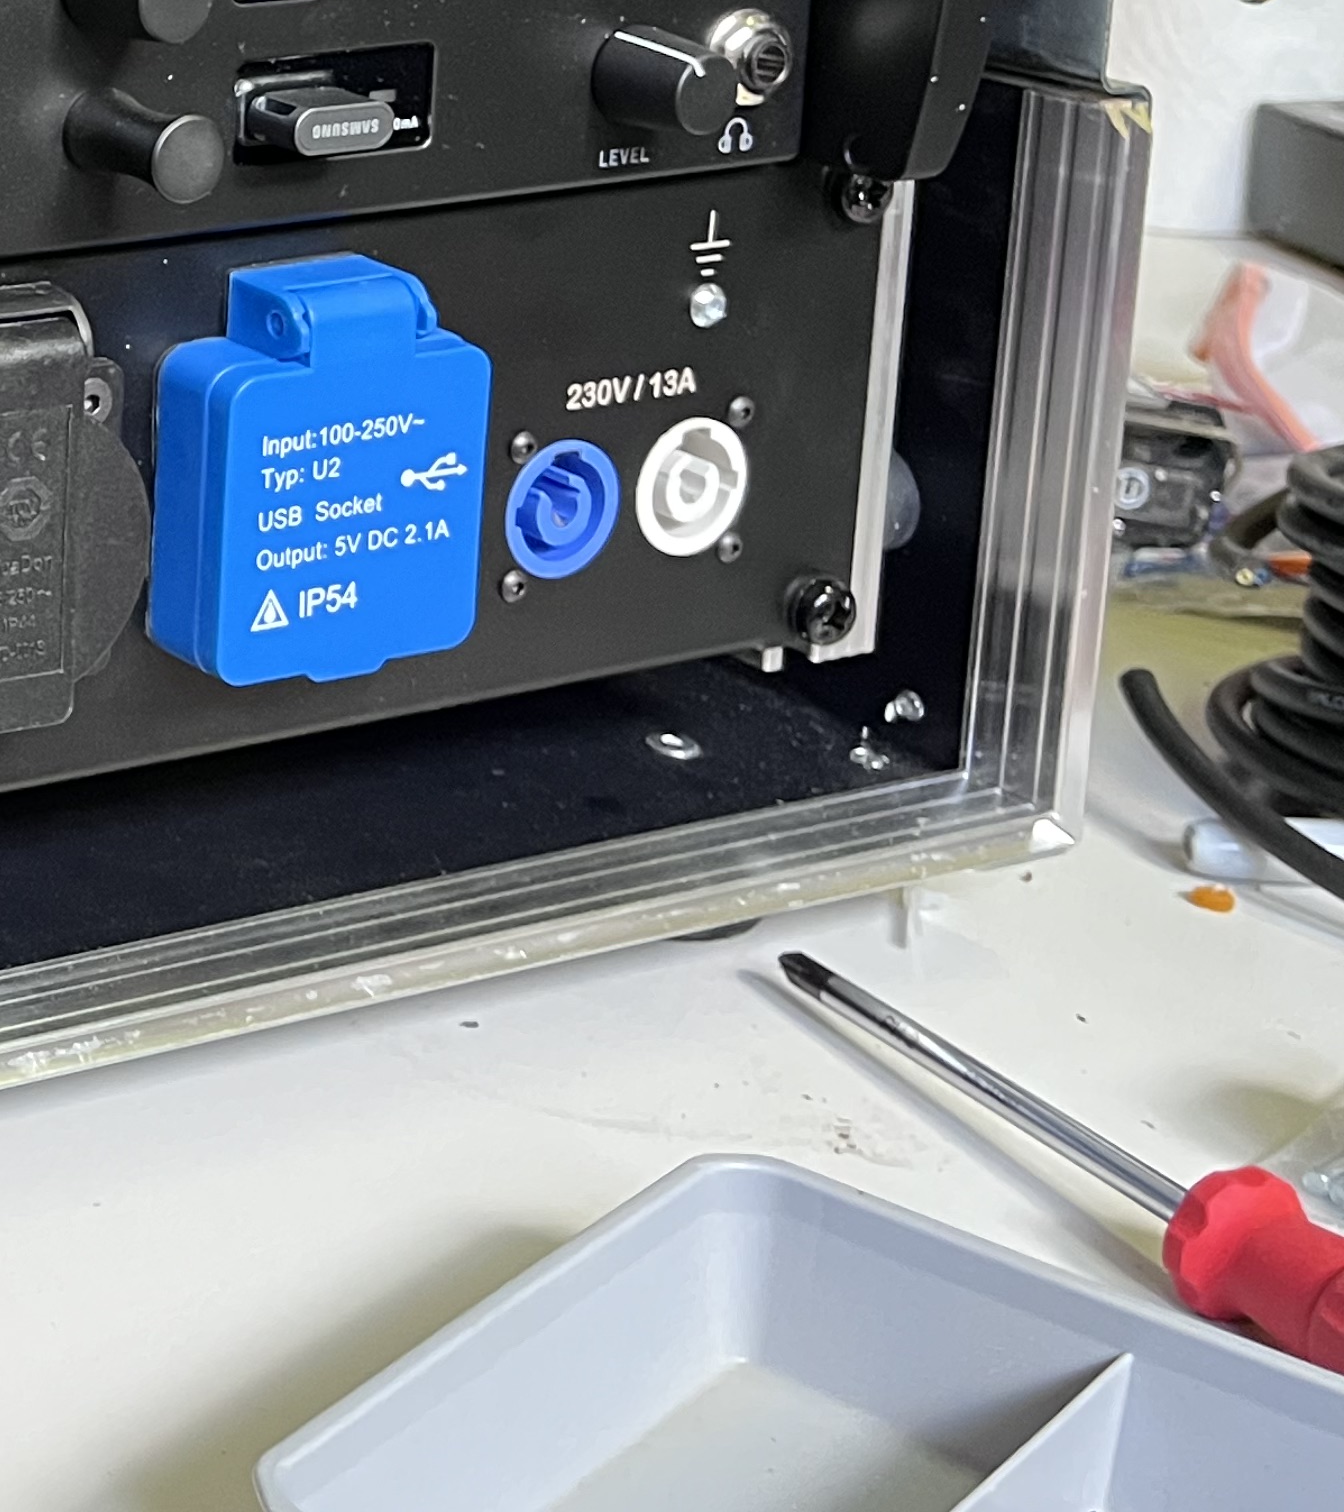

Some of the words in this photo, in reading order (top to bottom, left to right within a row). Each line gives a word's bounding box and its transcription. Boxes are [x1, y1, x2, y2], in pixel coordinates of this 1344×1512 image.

[598, 148, 650, 168] LEVEL
[261, 467, 305, 493] Typ:
[312, 456, 341, 481] U2
[258, 505, 303, 532] USB
[315, 492, 383, 522] Socket
[256, 541, 328, 571] Output:
[334, 532, 362, 557] 5V
[367, 526, 399, 551] DC
[404, 518, 450, 545] 2.1A
[298, 580, 358, 619] IP54
